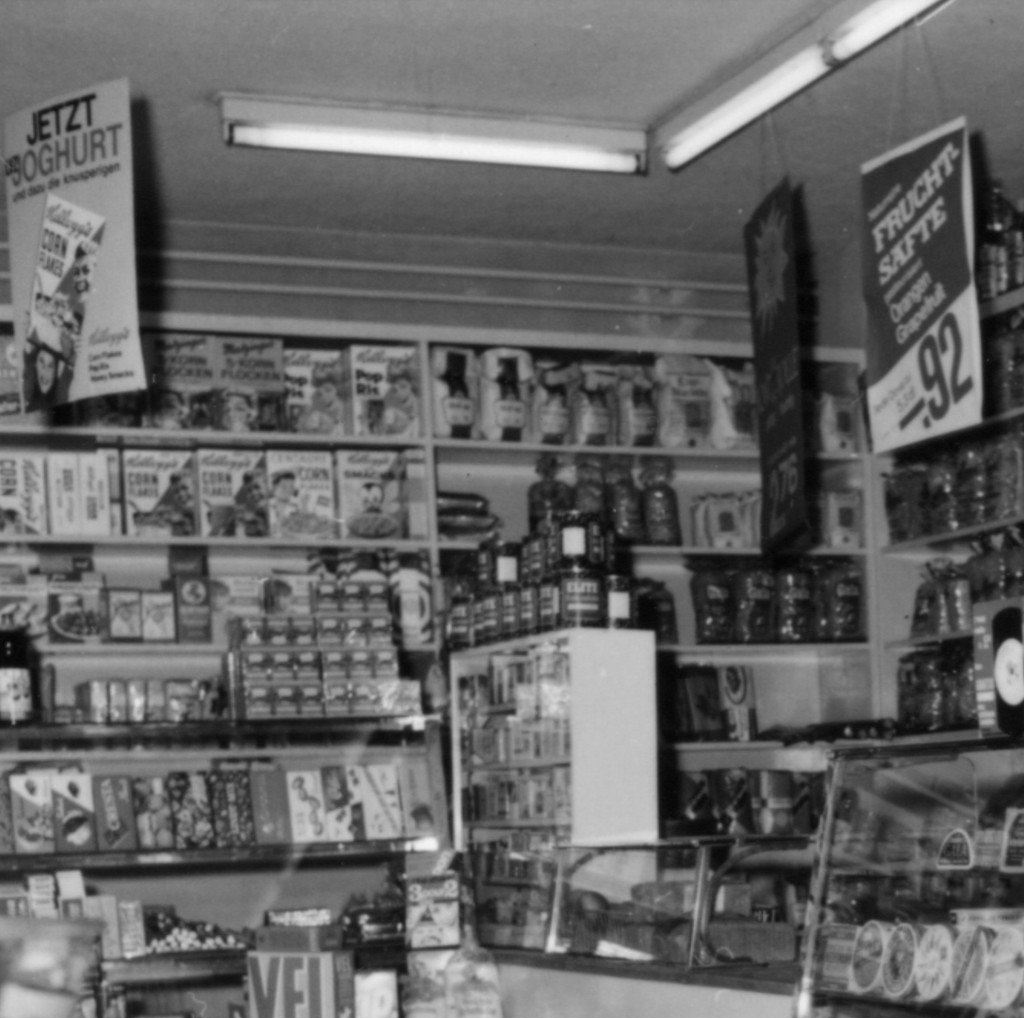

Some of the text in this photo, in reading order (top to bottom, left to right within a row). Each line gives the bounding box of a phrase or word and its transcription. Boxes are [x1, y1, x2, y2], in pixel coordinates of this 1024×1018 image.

[26, 92, 97, 146] JETZT
[12, 122, 123, 187] JOGHURT
[41, 227, 70, 260] CORN
[355, 368, 383, 384] Pop
[127, 471, 159, 485] CORN
[201, 470, 232, 485] CORN
[299, 466, 330, 480] CORN
